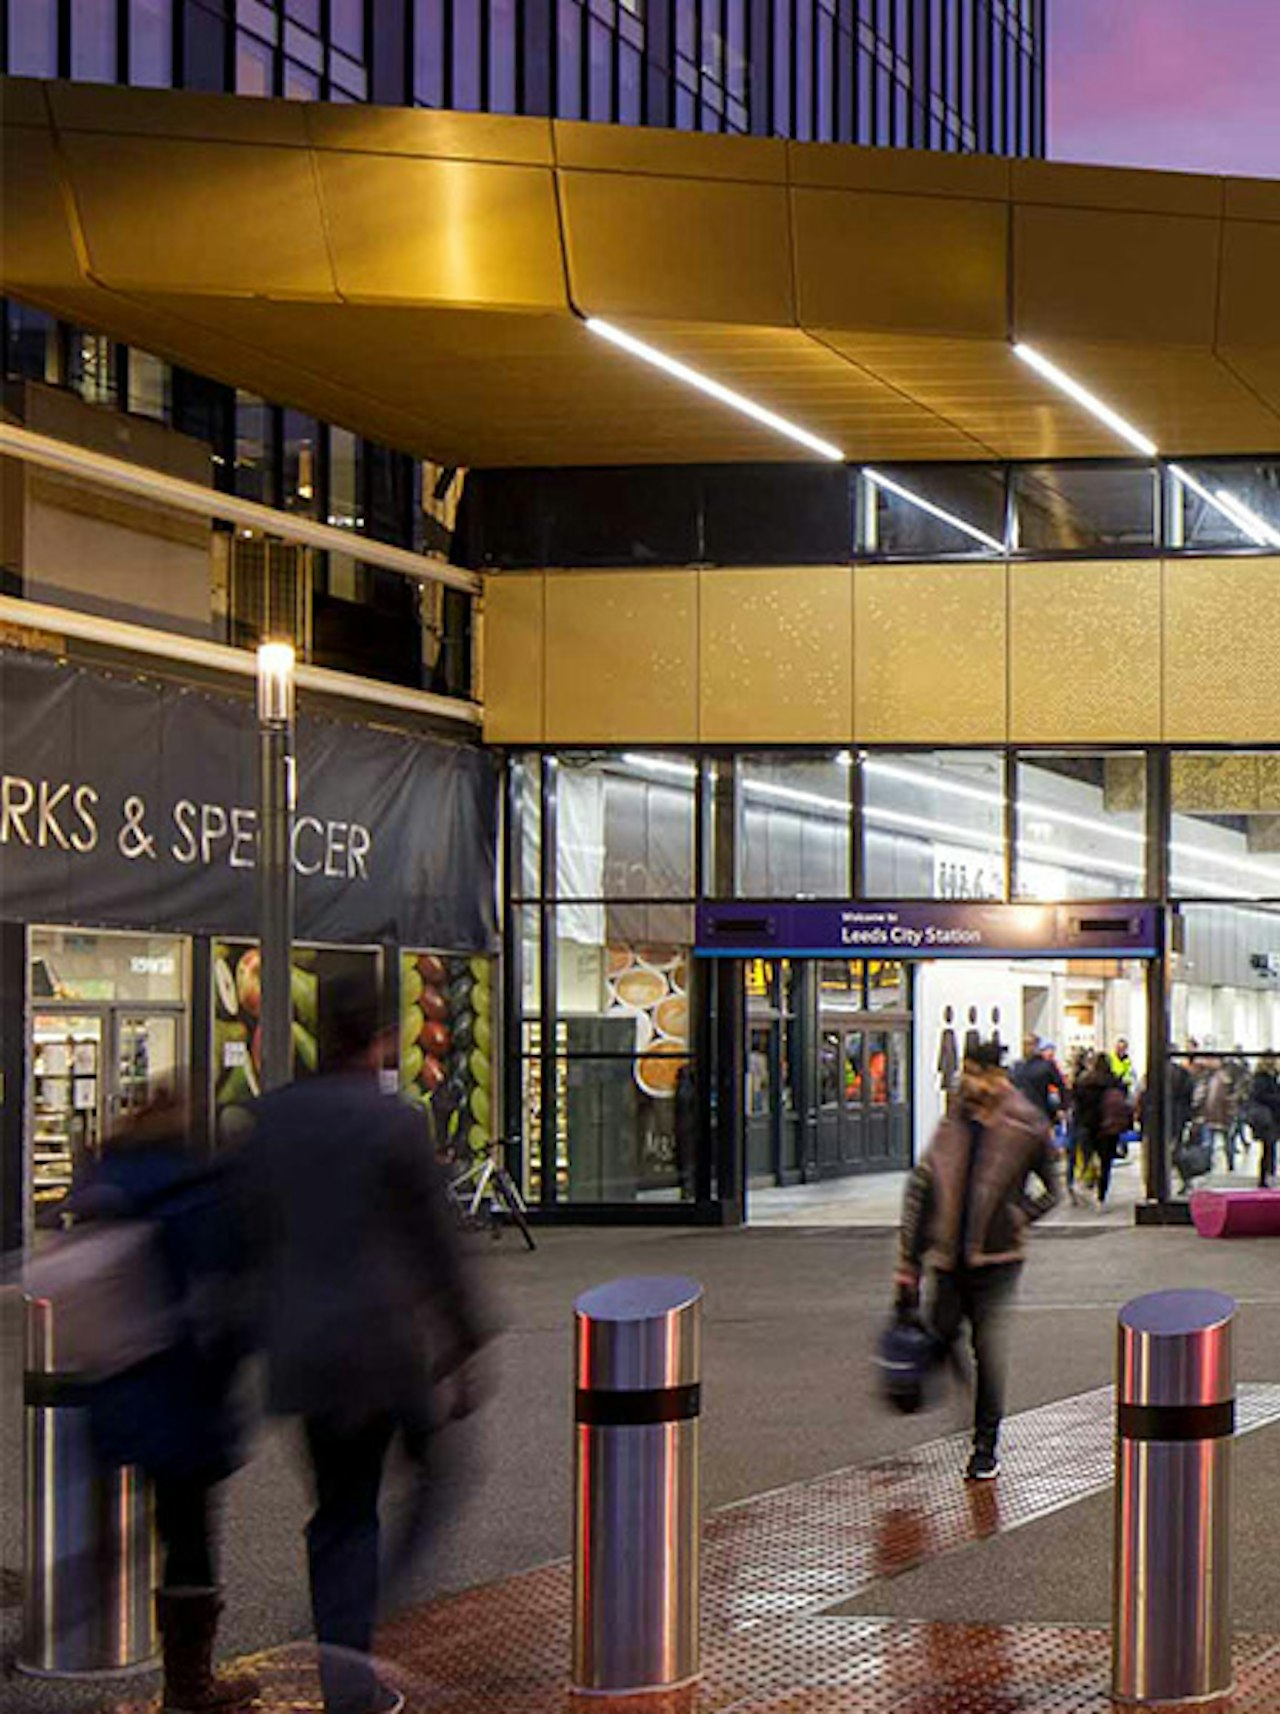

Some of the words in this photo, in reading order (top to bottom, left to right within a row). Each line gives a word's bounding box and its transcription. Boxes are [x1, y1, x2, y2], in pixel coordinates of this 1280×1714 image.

[119, 796, 156, 859] &
[172, 799, 371, 881] SPECER
[841, 927, 888, 944] Leeds
[890, 927, 924, 947] City
[925, 926, 981, 944] Station
